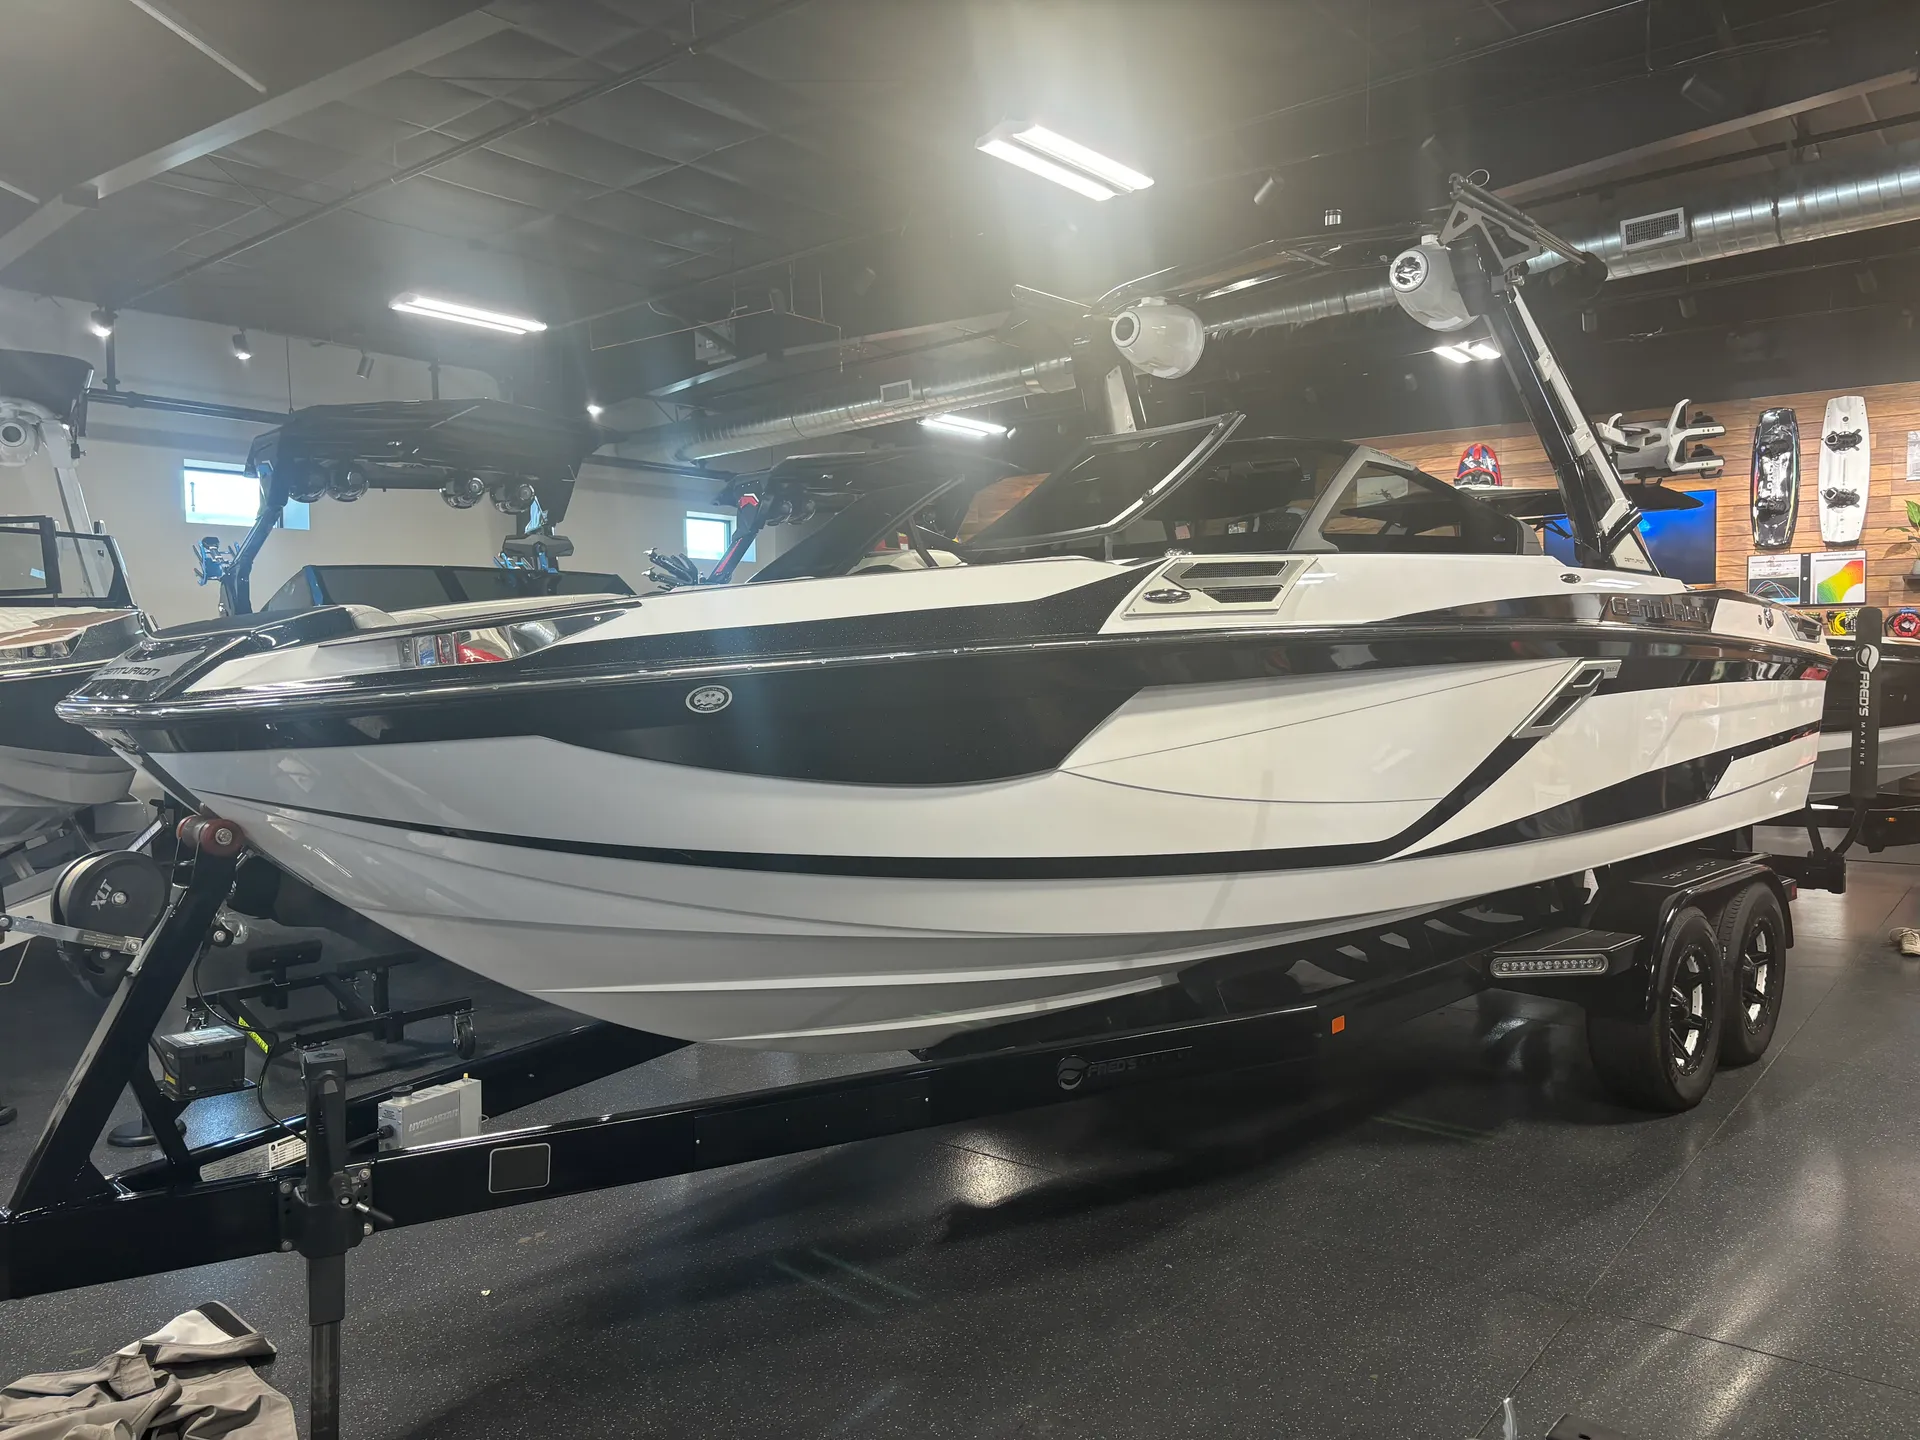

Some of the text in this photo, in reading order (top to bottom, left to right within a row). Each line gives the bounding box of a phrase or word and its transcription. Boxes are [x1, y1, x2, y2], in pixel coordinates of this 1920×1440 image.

[1609, 596, 1710, 624] CENTURION
[98, 666, 161, 677] CENTURION
[1858, 670, 1870, 717] FRED'S
[90, 878, 112, 912] XLT
